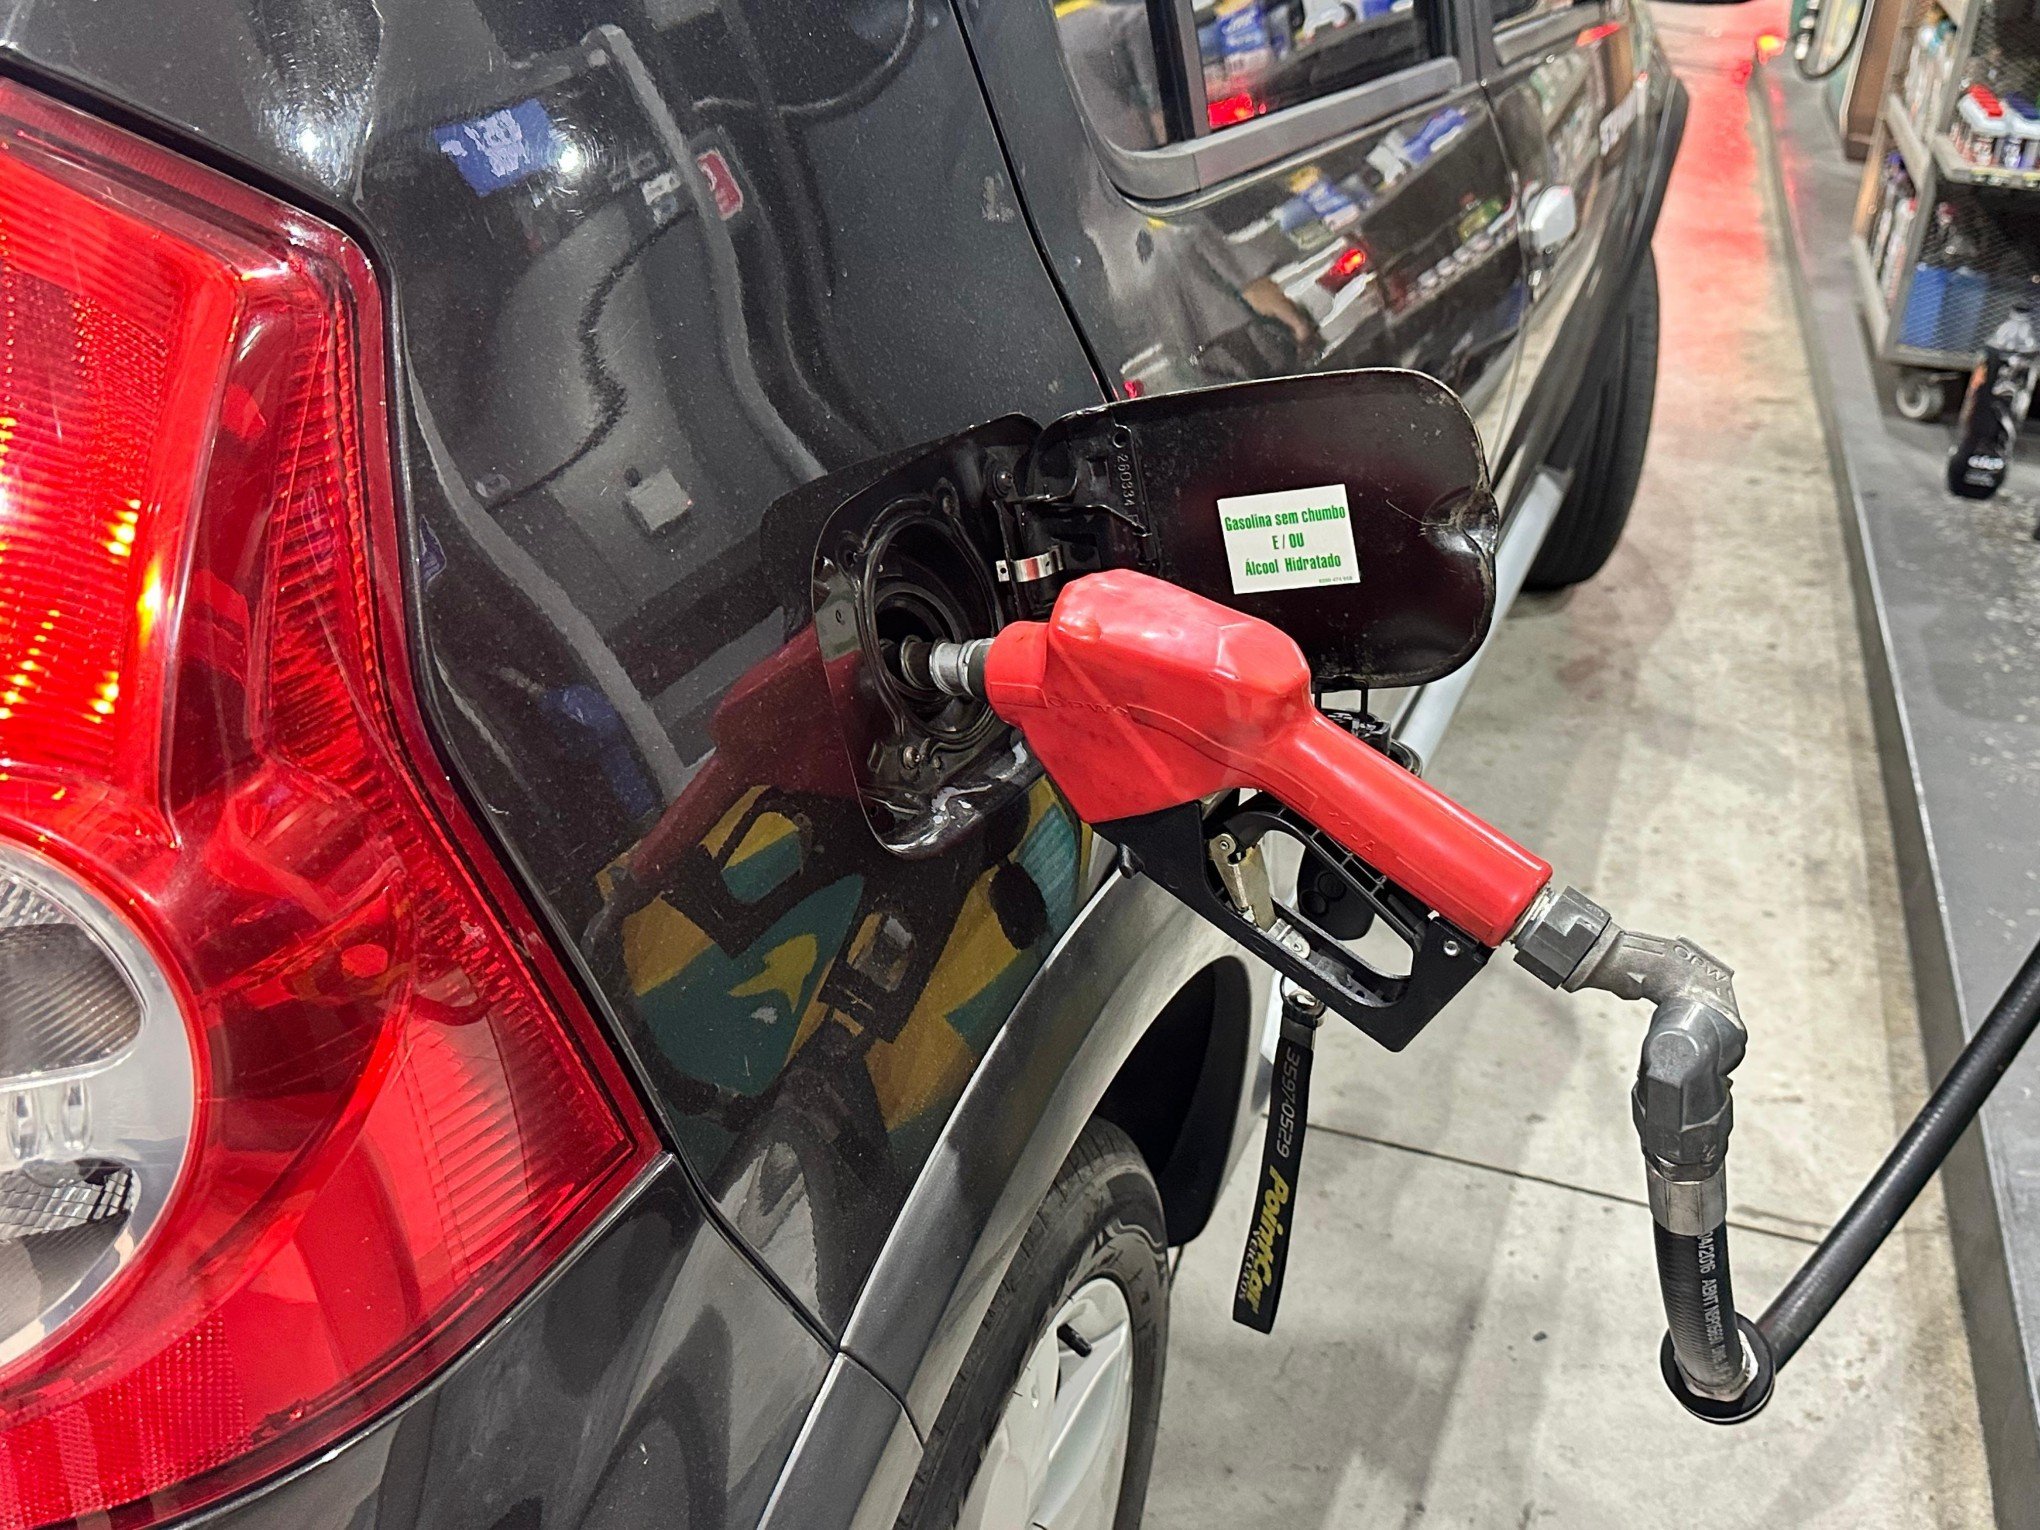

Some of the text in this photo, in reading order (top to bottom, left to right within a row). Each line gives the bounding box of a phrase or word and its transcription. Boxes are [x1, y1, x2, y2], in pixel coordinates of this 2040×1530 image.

[1117, 454, 1135, 506] 260334
[1224, 505, 1346, 532] Gasolina sem chumbo
[1272, 535, 1280, 550] E
[1289, 532, 1305, 549] OU
[1245, 553, 1342, 576] Álcool Hidratado
[1673, 944, 1729, 982] OPW
[1246, 1164, 1290, 1315] PointCar
[1702, 1279, 1720, 1307] ABNT
